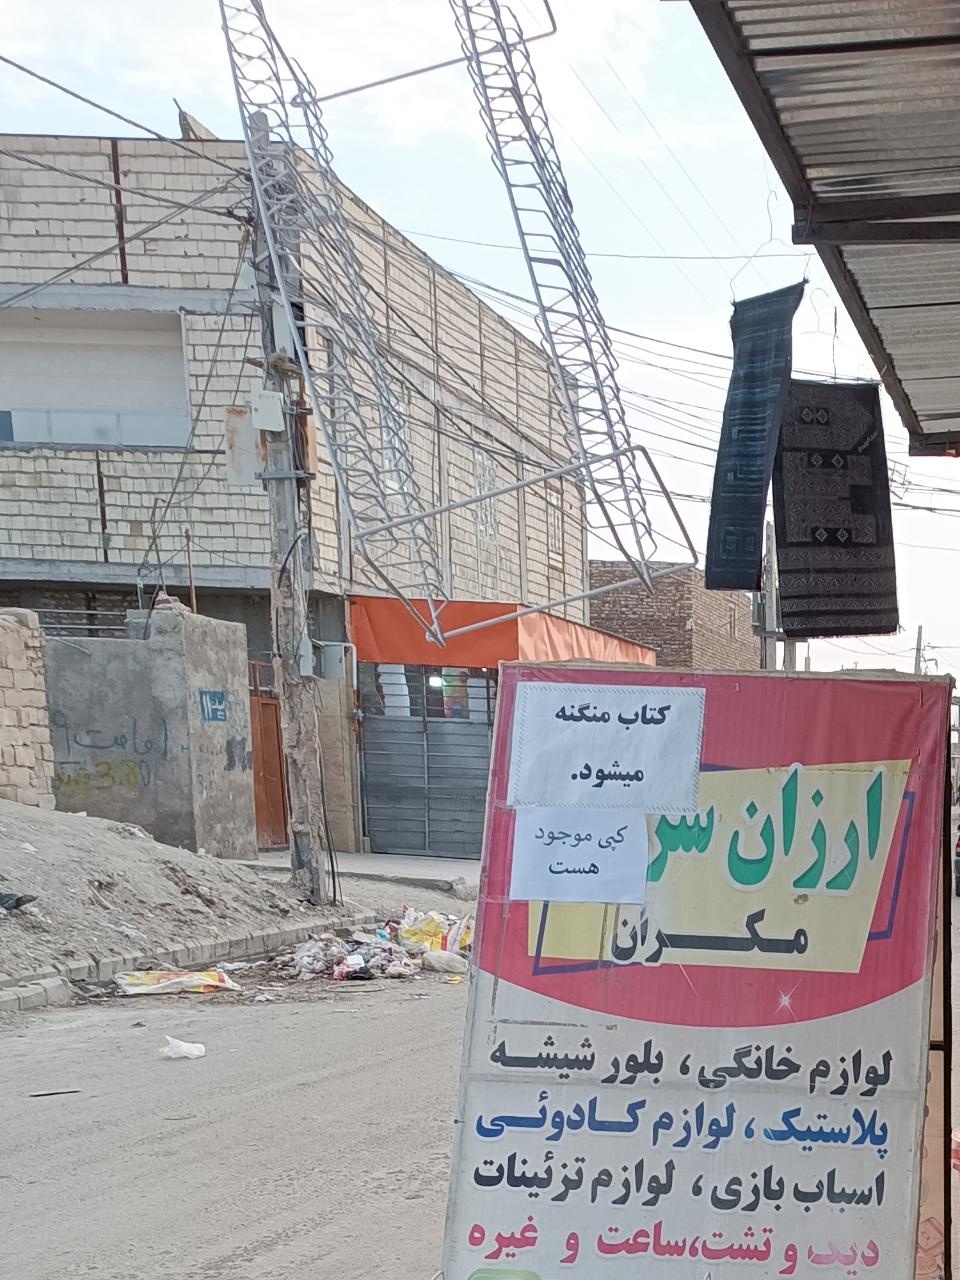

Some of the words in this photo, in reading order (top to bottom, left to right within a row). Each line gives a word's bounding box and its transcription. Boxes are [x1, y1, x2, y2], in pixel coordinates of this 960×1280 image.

[554, 702, 611, 724] منگنه
[617, 703, 671, 730] کتاب
[571, 760, 645, 788] میشود.
[534, 827, 592, 847] موجود
[597, 825, 628, 851] کپی
[647, 804, 714, 882] سر
[727, 768, 883, 891] ارزان
[548, 861, 600, 875] هست
[611, 907, 808, 962] مکران
[490, 1035, 595, 1079] شیشه
[601, 1038, 664, 1084] بلور
[809, 1049, 893, 1096] لوازم
[476, 1090, 647, 1141] کادوئی
[652, 1102, 736, 1149] لوازم
[474, 1151, 586, 1201] تزئینات
[591, 1158, 675, 1206] لوازم
[793, 1168, 885, 1213] اسباب
[468, 1215, 538, 1259] غیره
[560, 1232, 580, 1263] و
[779, 1243, 798, 1274] و
